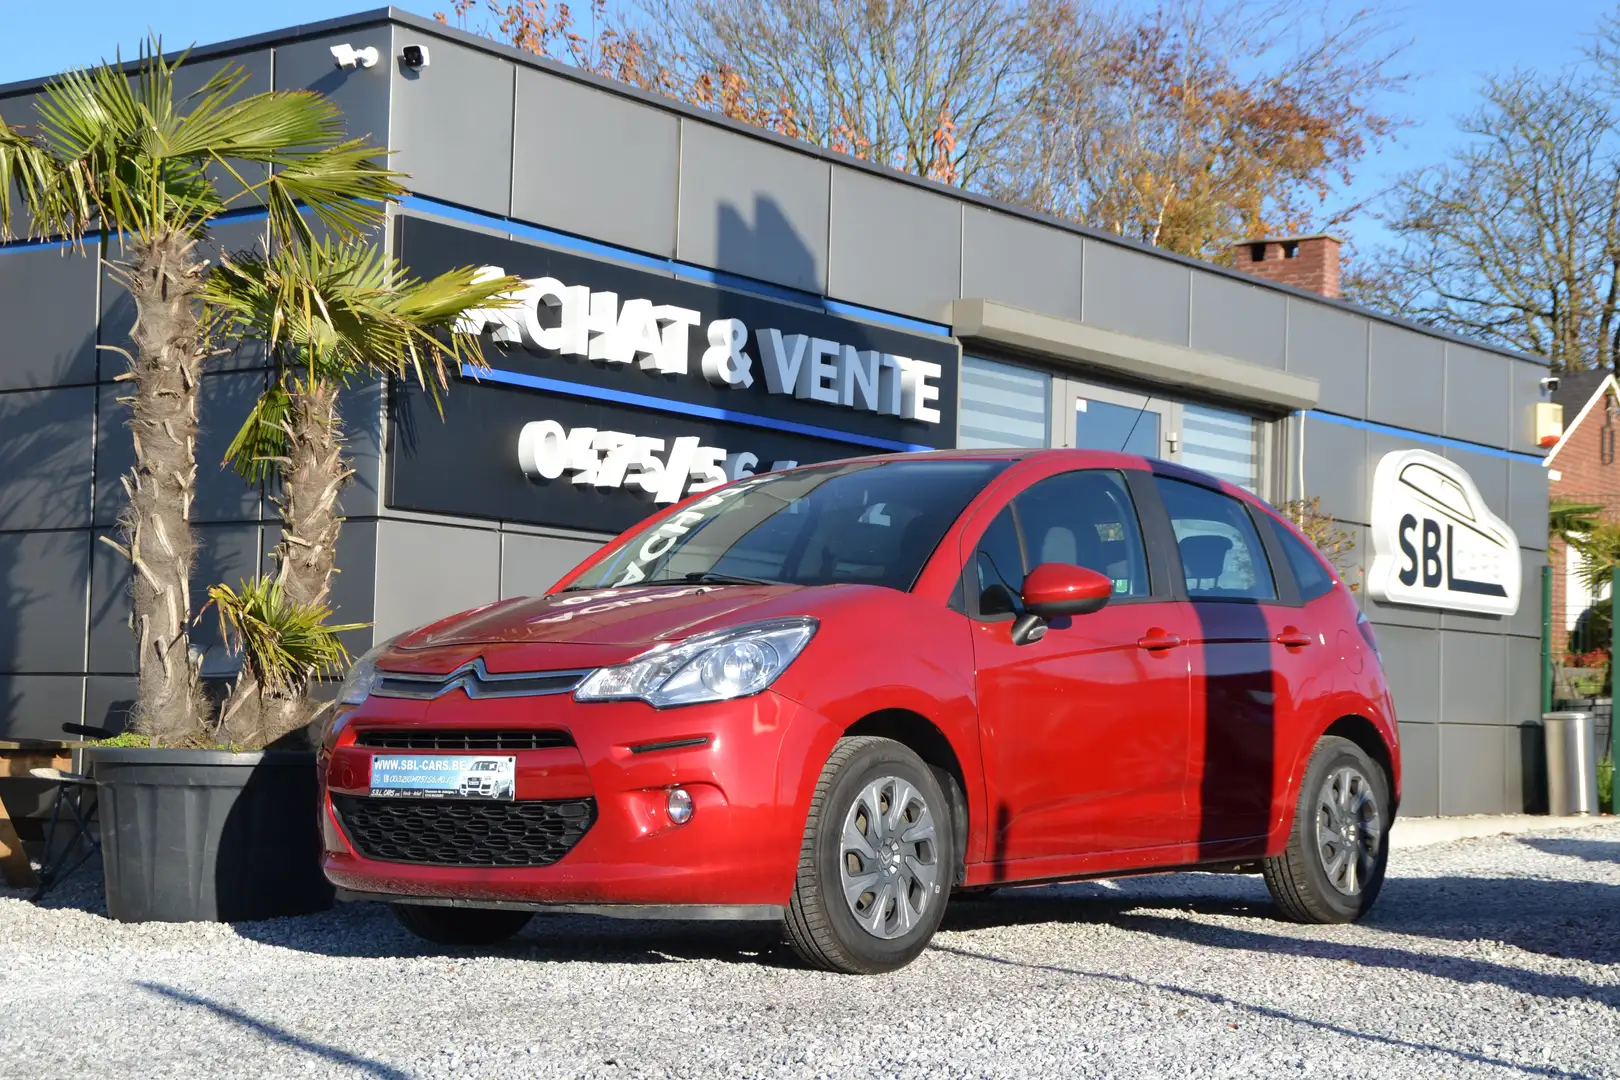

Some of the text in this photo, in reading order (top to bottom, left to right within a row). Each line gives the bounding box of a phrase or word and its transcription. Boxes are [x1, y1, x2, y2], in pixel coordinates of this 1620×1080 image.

[702, 318, 753, 390] &
[756, 328, 942, 424] VENTE
[1398, 513, 1509, 598] SBL
[374, 759, 467, 771] WWW.SBL-CARS.BE
